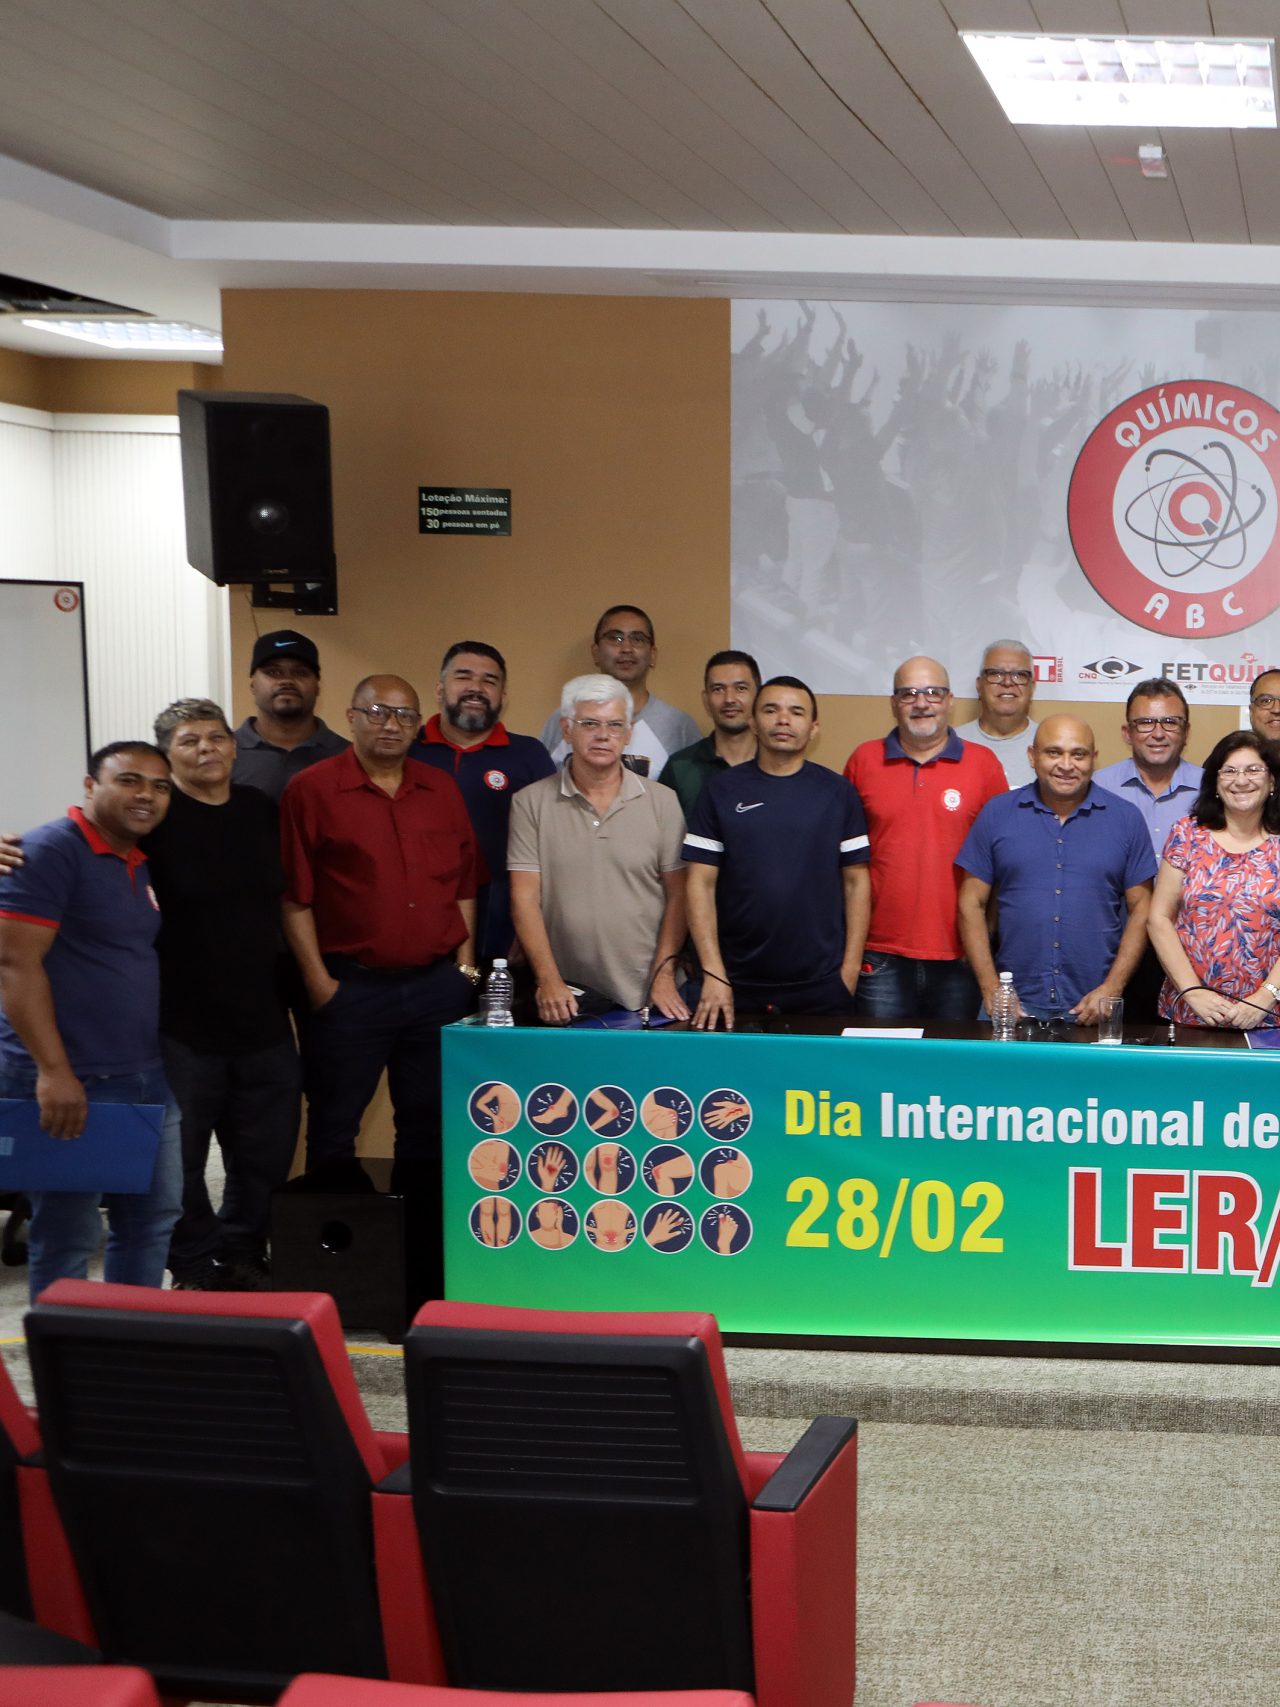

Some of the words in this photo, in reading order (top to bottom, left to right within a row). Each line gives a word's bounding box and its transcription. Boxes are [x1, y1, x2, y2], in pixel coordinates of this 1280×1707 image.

[1115, 388, 1278, 453] QUÍMICOS
[422, 493, 462, 504] Lotação
[465, 494, 508, 504] Máxima:
[426, 519, 440, 529] 30
[442, 521, 473, 529] pessoas
[490, 520, 500, 529] pé
[785, 1089, 862, 1137] Dia
[880, 1092, 1204, 1147] Internacional
[1223, 1102, 1280, 1149] de
[785, 1176, 1004, 1258] 28/02
